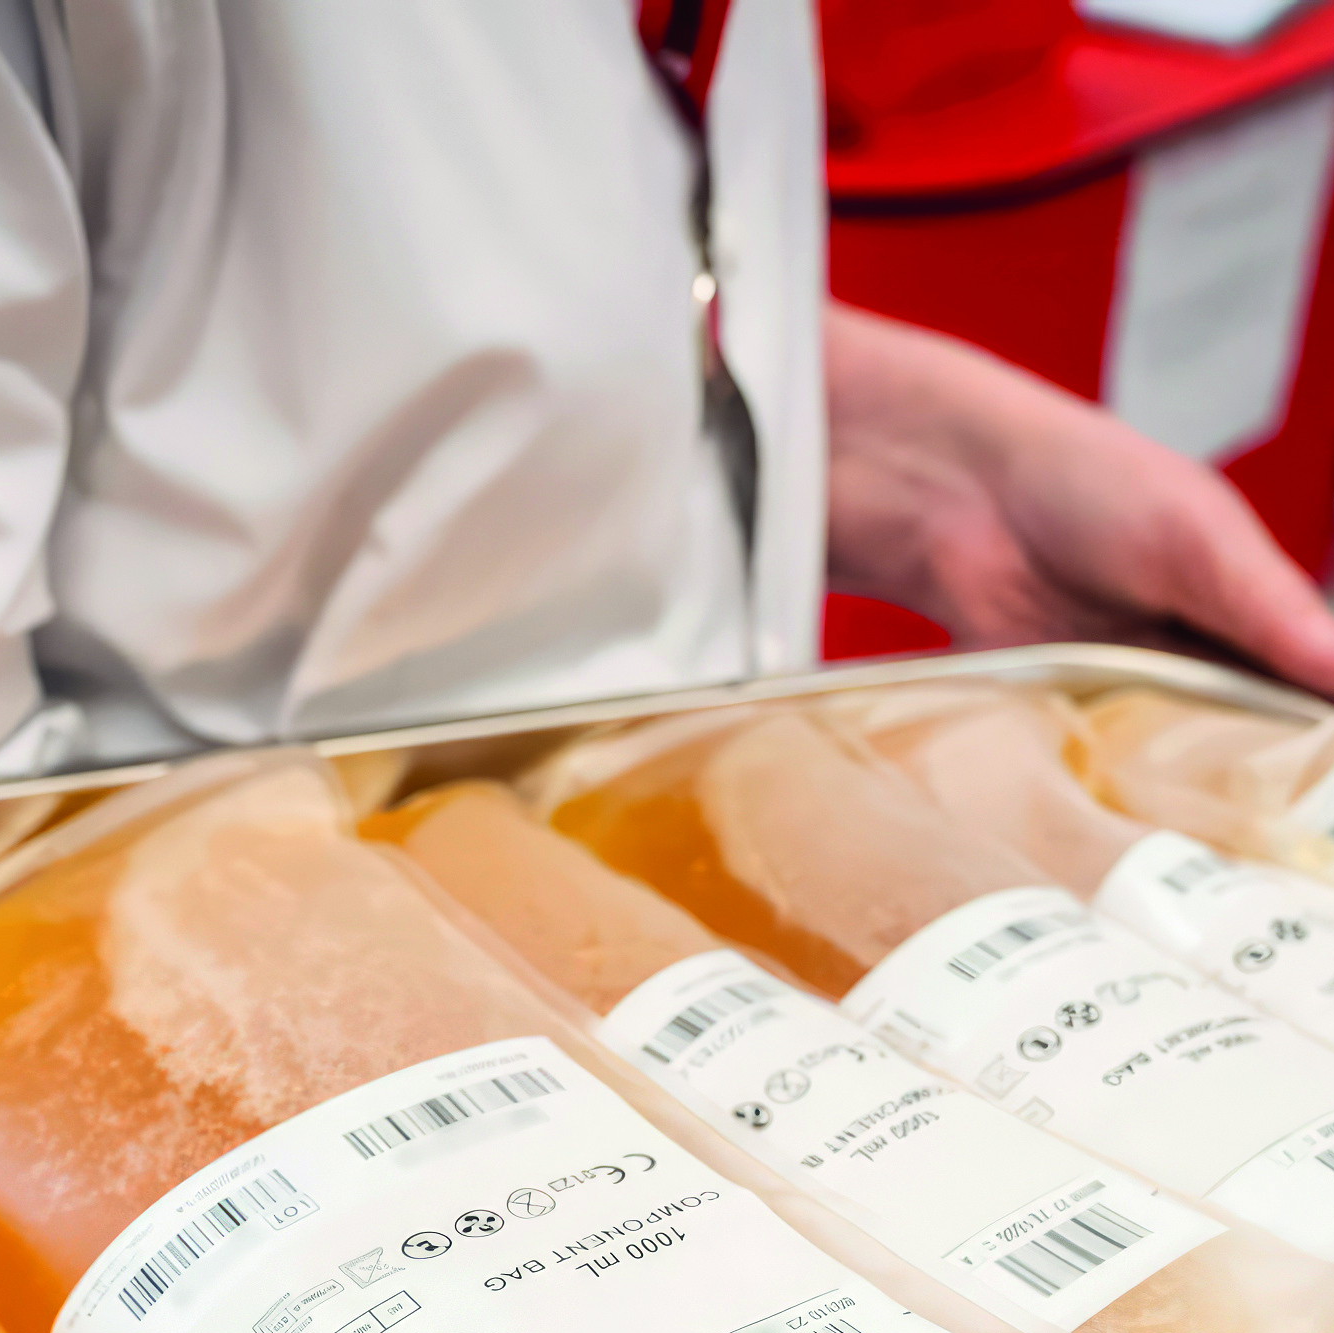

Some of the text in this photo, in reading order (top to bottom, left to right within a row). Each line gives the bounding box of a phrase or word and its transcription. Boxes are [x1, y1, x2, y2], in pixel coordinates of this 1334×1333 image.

[483, 1191, 719, 1292] COMPONENT BAG
[575, 1226, 686, 1277] 1000 mL
